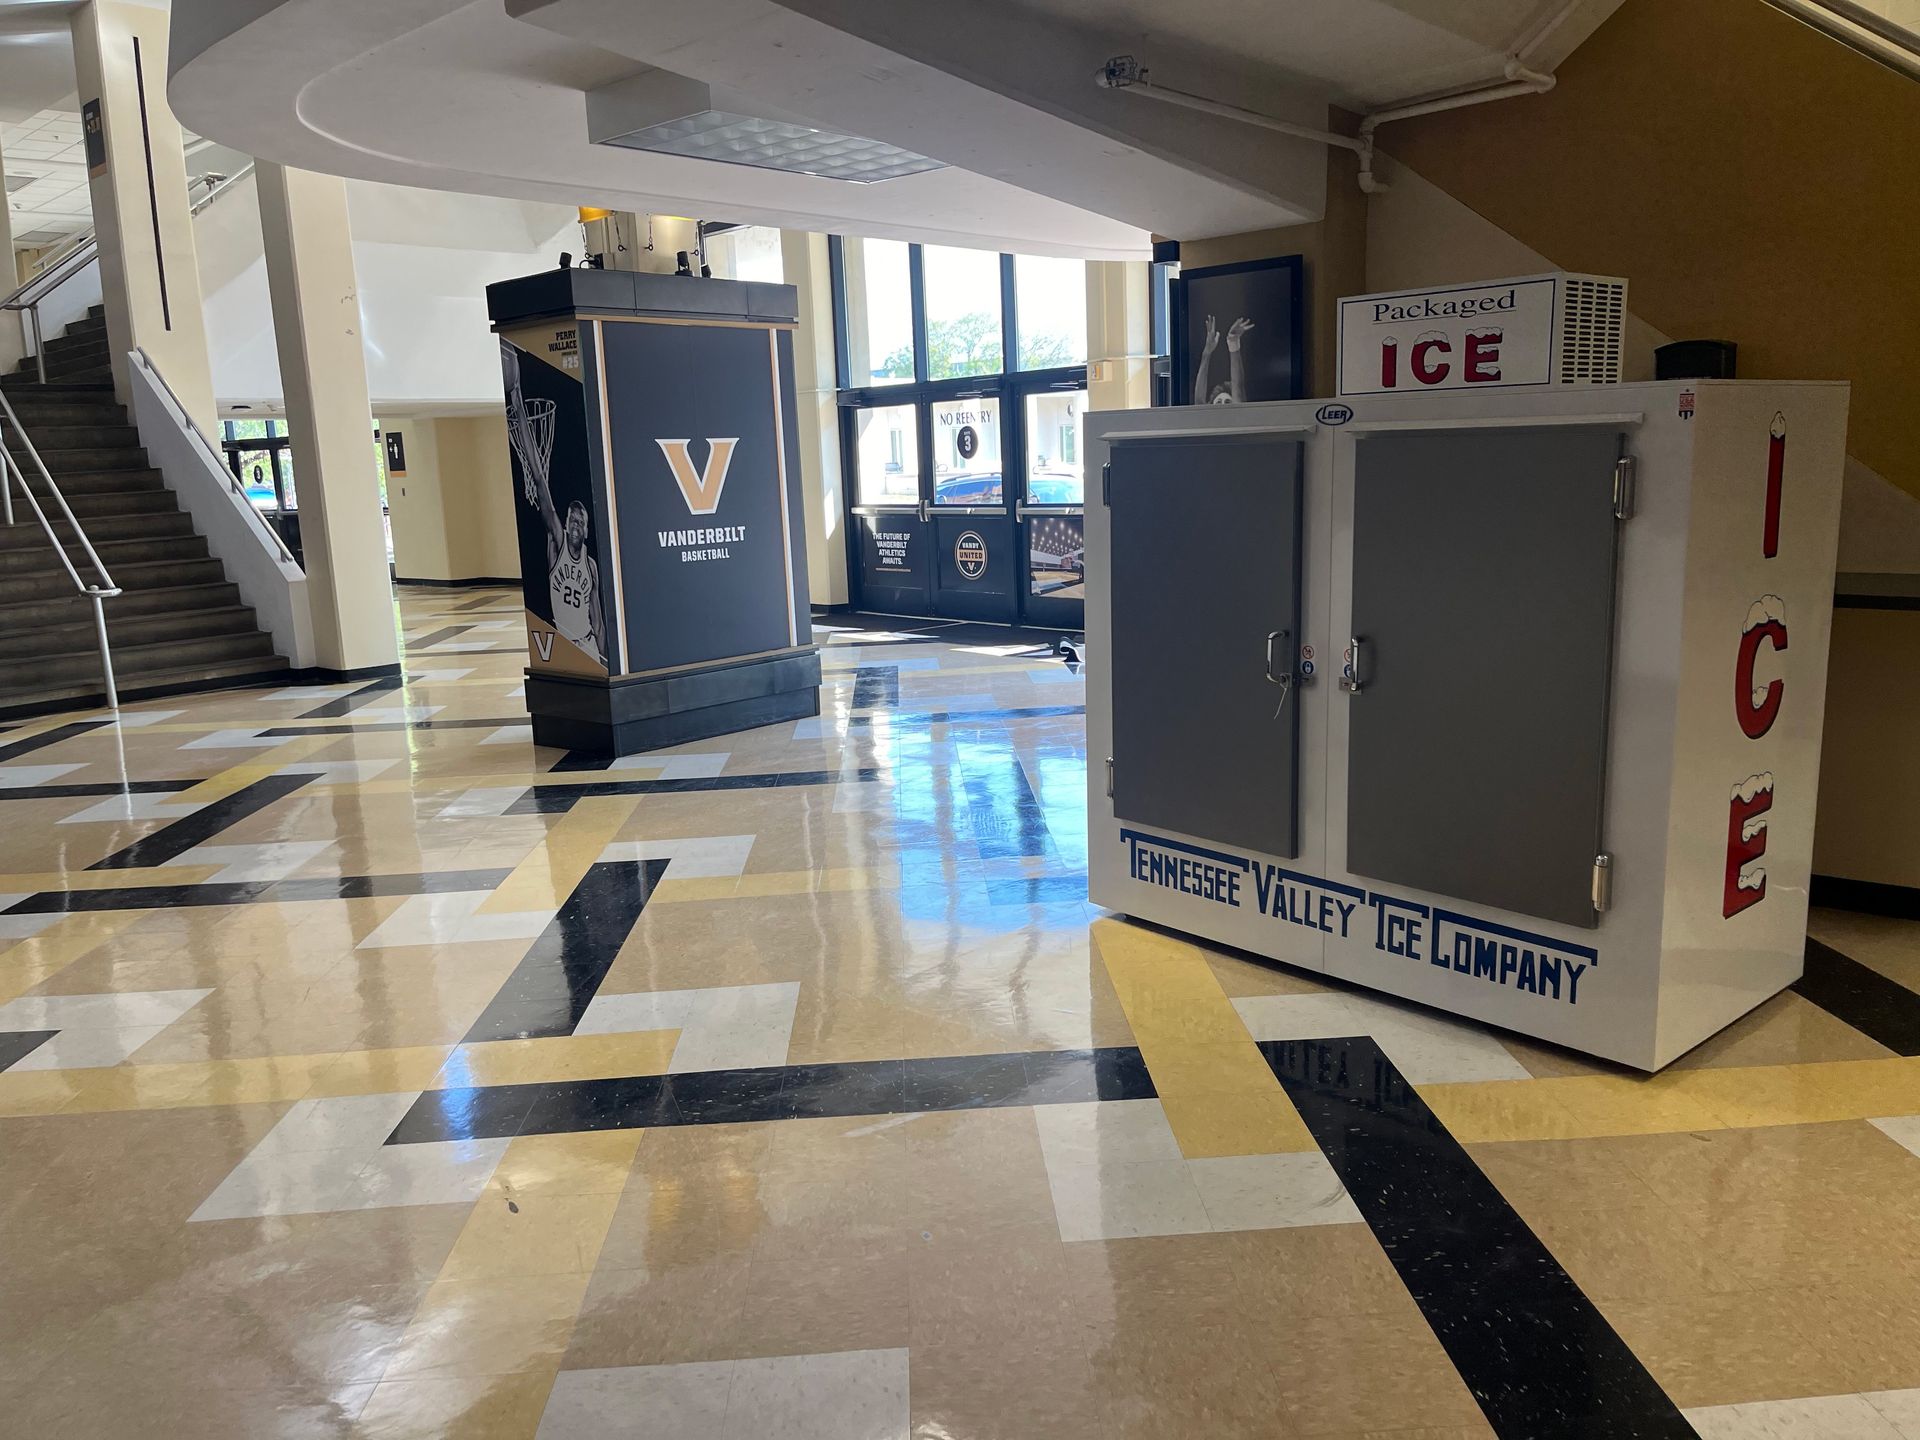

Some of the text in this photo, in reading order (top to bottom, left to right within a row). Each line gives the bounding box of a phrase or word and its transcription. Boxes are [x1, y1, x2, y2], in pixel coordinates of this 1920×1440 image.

[1372, 290, 1517, 323] Packaged
[555, 329, 576, 341] PERRY
[548, 340, 577, 352] WALLACE
[1380, 327, 1504, 388] ICE
[940, 409, 991, 426] NO REENRY
[1321, 405, 1348, 423] LEER
[964, 435, 972, 452] 3
[654, 437, 740, 515] V
[658, 526, 746, 548] VANDERBILT
[872, 532, 911, 541] THE FUTURE OF
[876, 540, 907, 549] VANDERBILT
[681, 547, 730, 562] BASKETBALL
[878, 549, 906, 557] ATHLETICS
[960, 551, 983, 559] UNITED
[563, 586, 581, 608] 25
[1120, 827, 1599, 1004] TENNESSEE VALLEY ICE COMPANY
